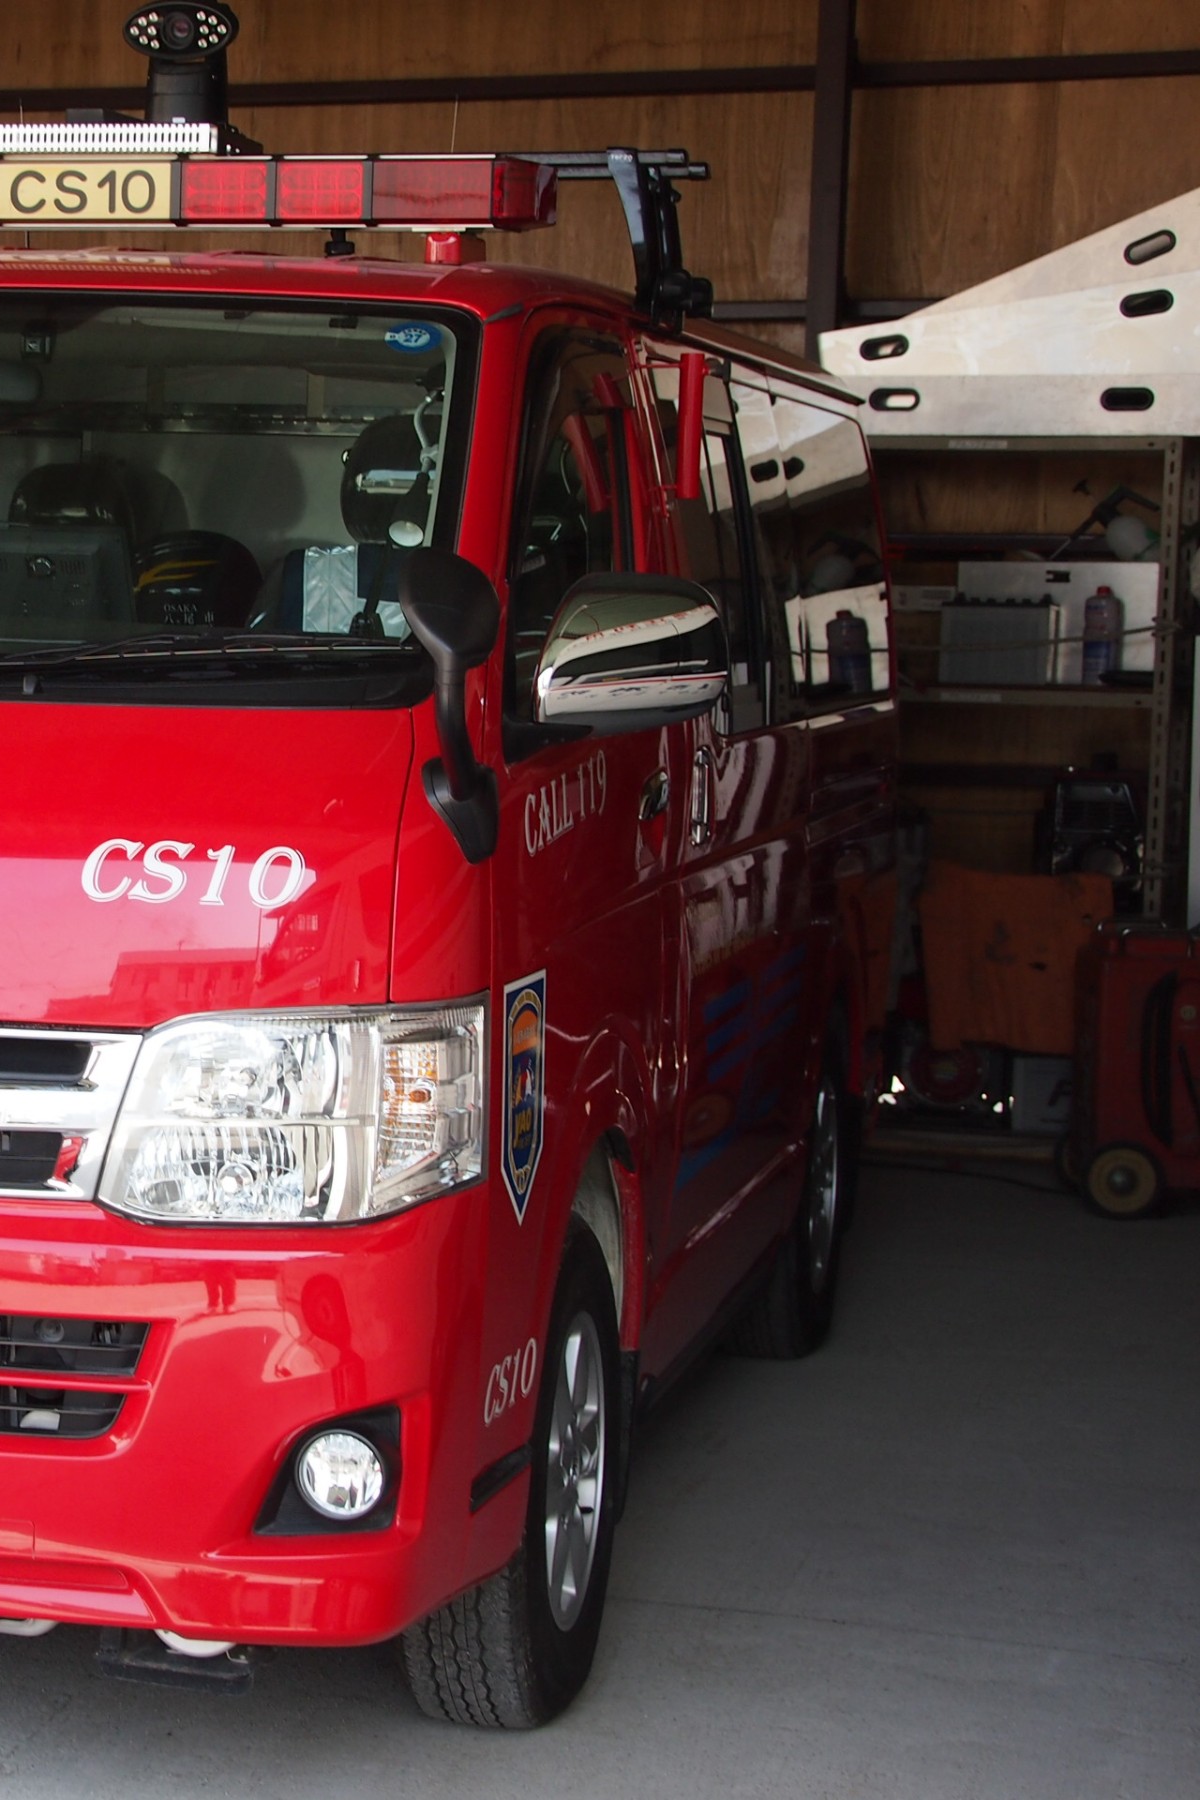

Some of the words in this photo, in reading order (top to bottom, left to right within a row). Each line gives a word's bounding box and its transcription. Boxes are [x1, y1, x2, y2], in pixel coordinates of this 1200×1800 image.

[10, 169, 156, 214] CS10
[524, 777, 575, 857] CALL
[577, 748, 607, 821] 119
[81, 838, 306, 909] CS10
[484, 1337, 537, 1428] CS10
